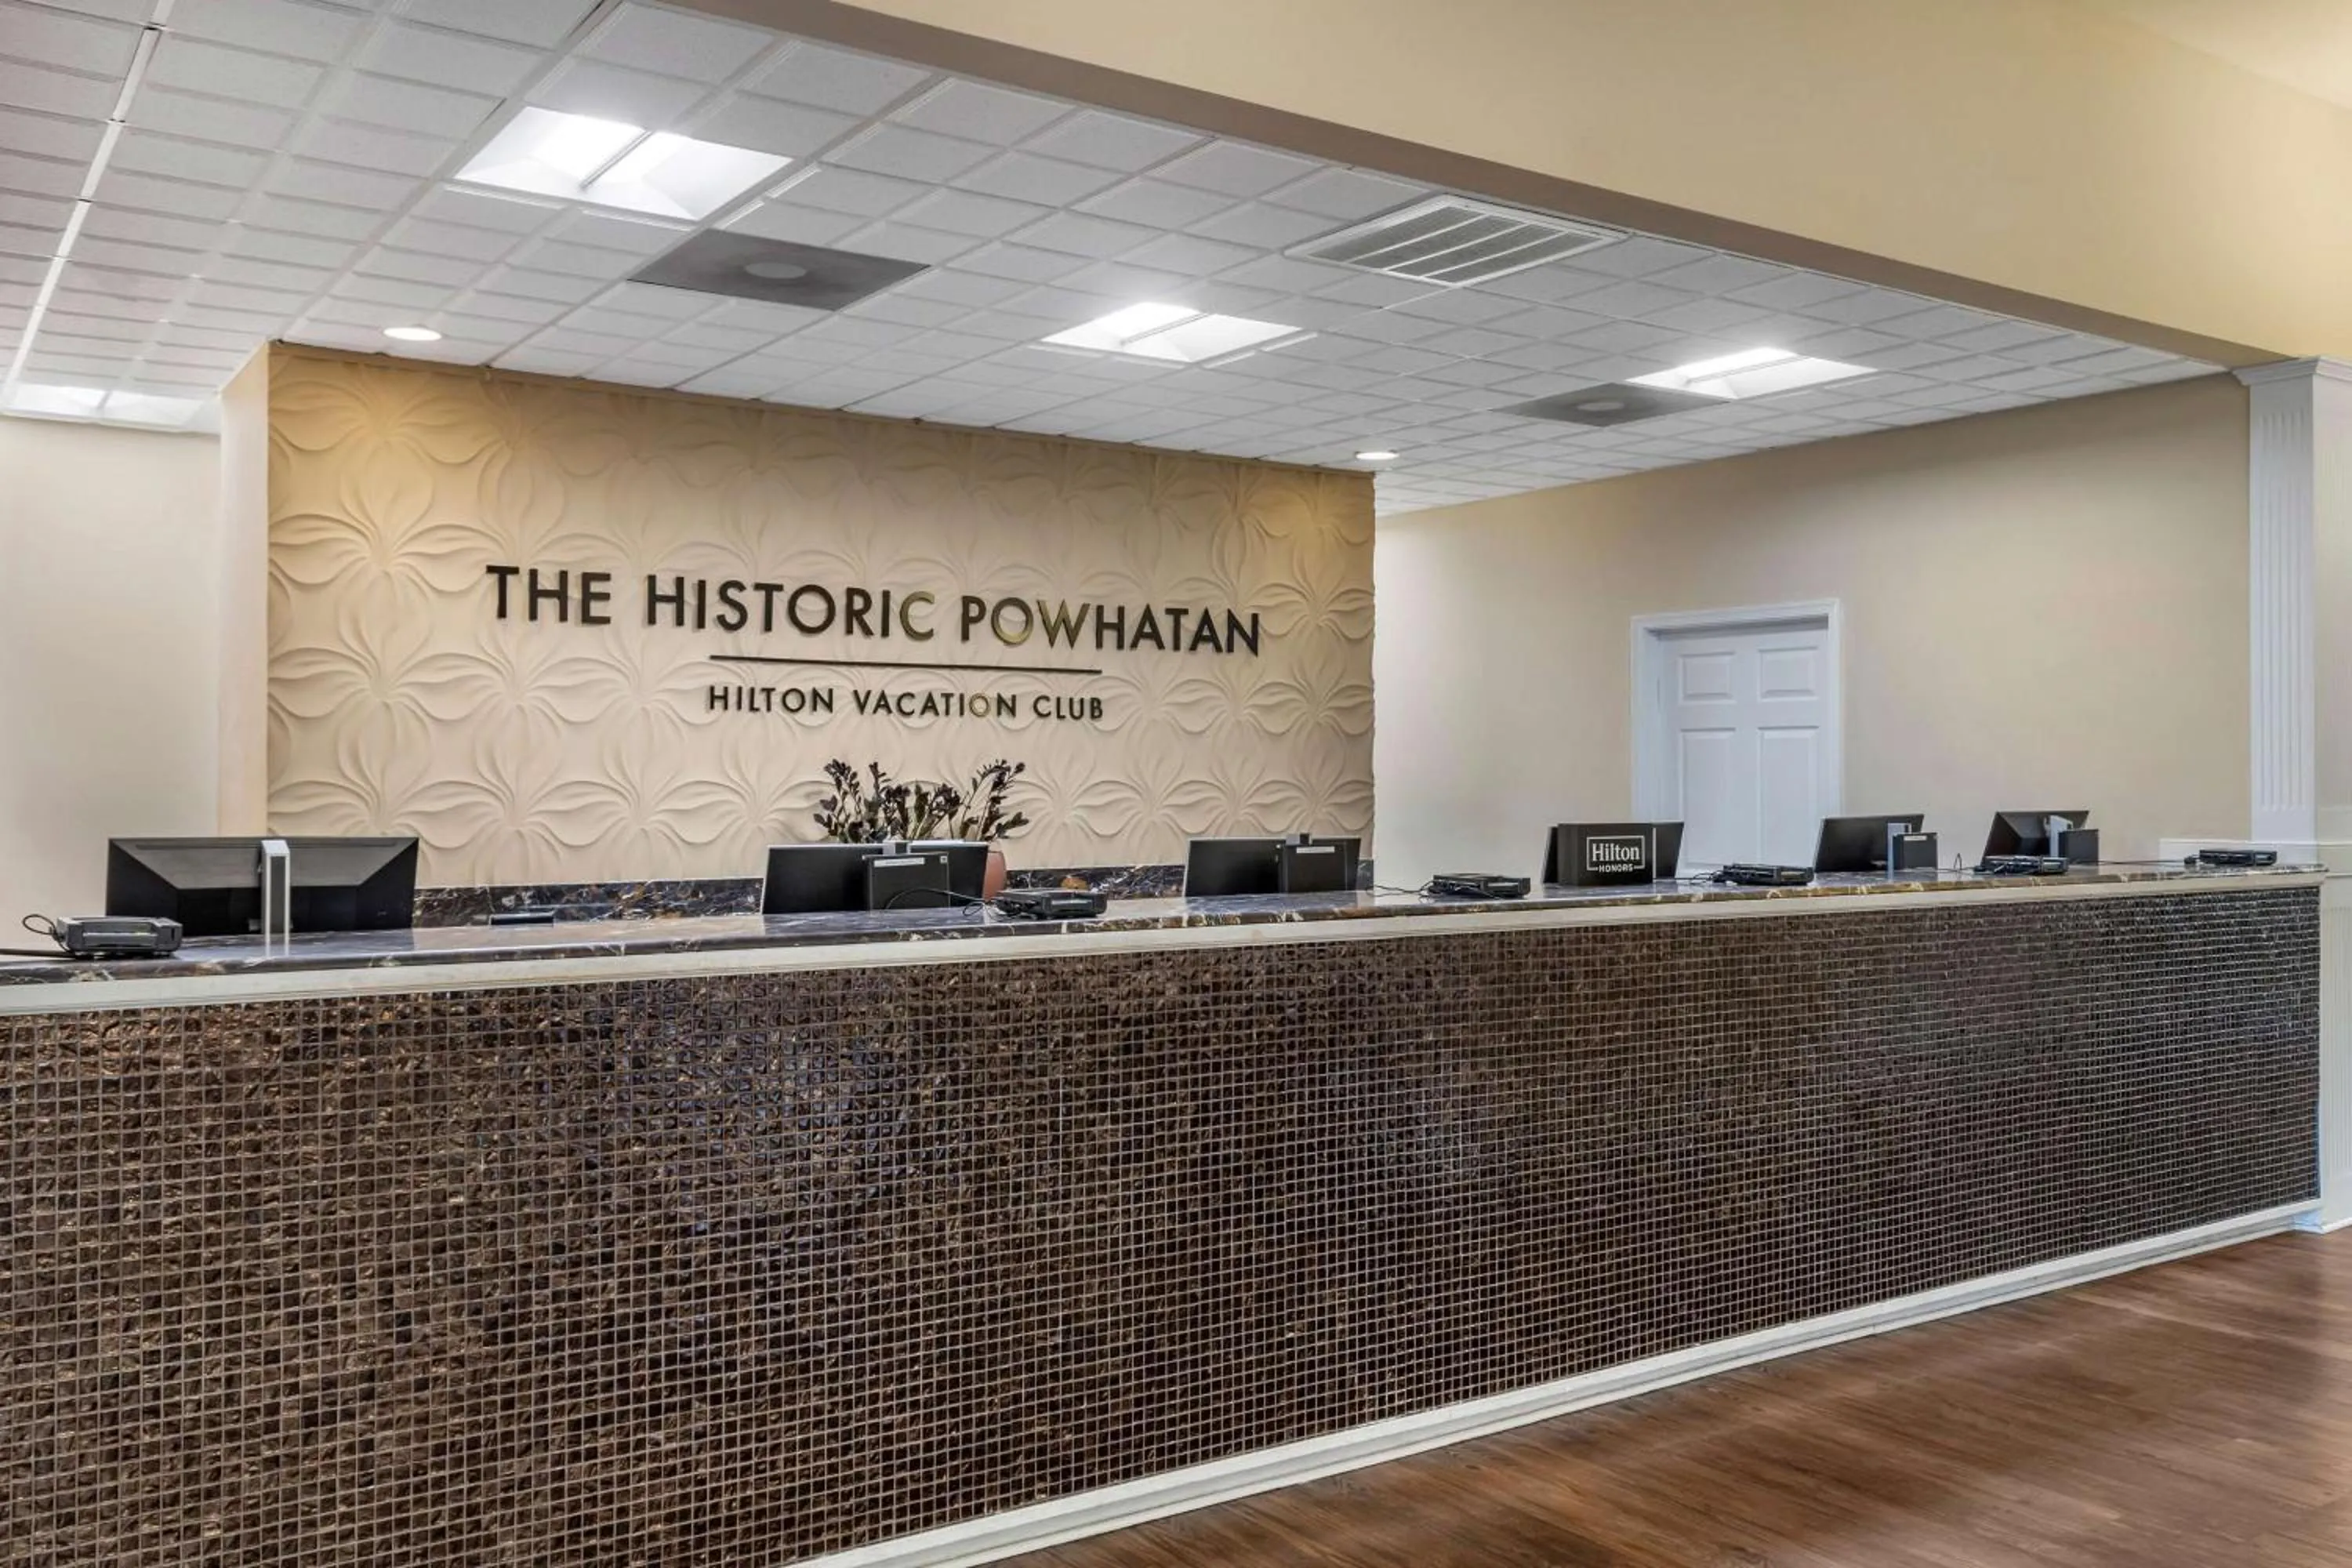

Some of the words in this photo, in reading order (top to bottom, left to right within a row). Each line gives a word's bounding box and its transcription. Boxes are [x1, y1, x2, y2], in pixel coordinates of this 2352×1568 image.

[486, 564, 612, 625] THE
[646, 574, 935, 641] HISTORIC
[960, 594, 1261, 657] POWHATAN
[708, 685, 834, 714] HILTON
[852, 689, 1017, 718] VACATION
[1032, 694, 1104, 720] CLUB
[1592, 843, 1640, 862] Hilton
[1599, 864, 1633, 873] HONORS
